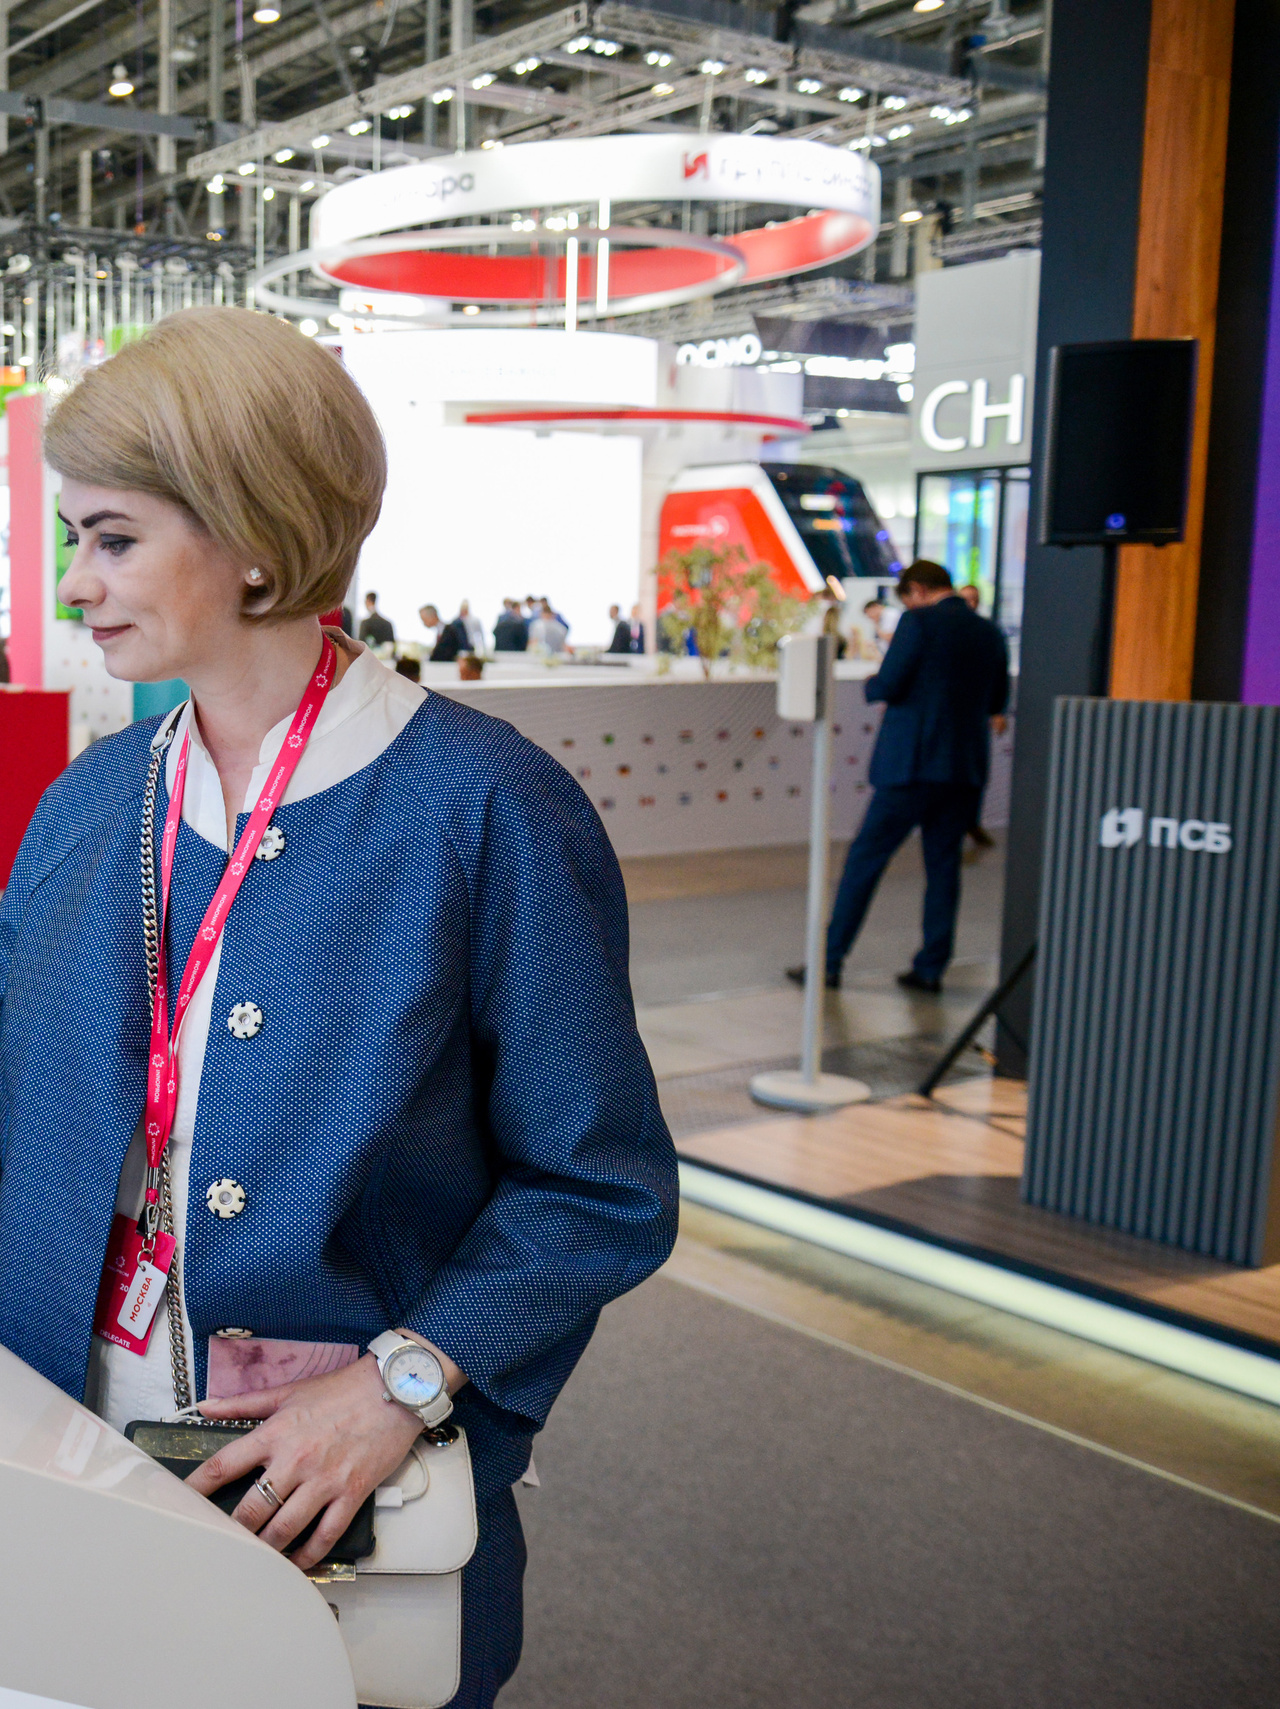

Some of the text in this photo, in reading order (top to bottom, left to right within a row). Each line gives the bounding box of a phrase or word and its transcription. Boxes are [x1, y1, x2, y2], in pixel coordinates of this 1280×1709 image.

[297, 703, 313, 734] INNOPROM
[268, 766, 285, 797] INNOPROM
[240, 830, 256, 862] INNOPROM
[1150, 816, 1232, 854] ПСБ
[210, 894, 228, 926] INNOPROM
[186, 960, 201, 993] INNOPROM
[153, 1069, 161, 1103] INNOPROM
[119, 1283, 129, 1293] 20
[129, 1277, 152, 1322] МОСКВА
[100, 1328, 131, 1349] DELEGATE
